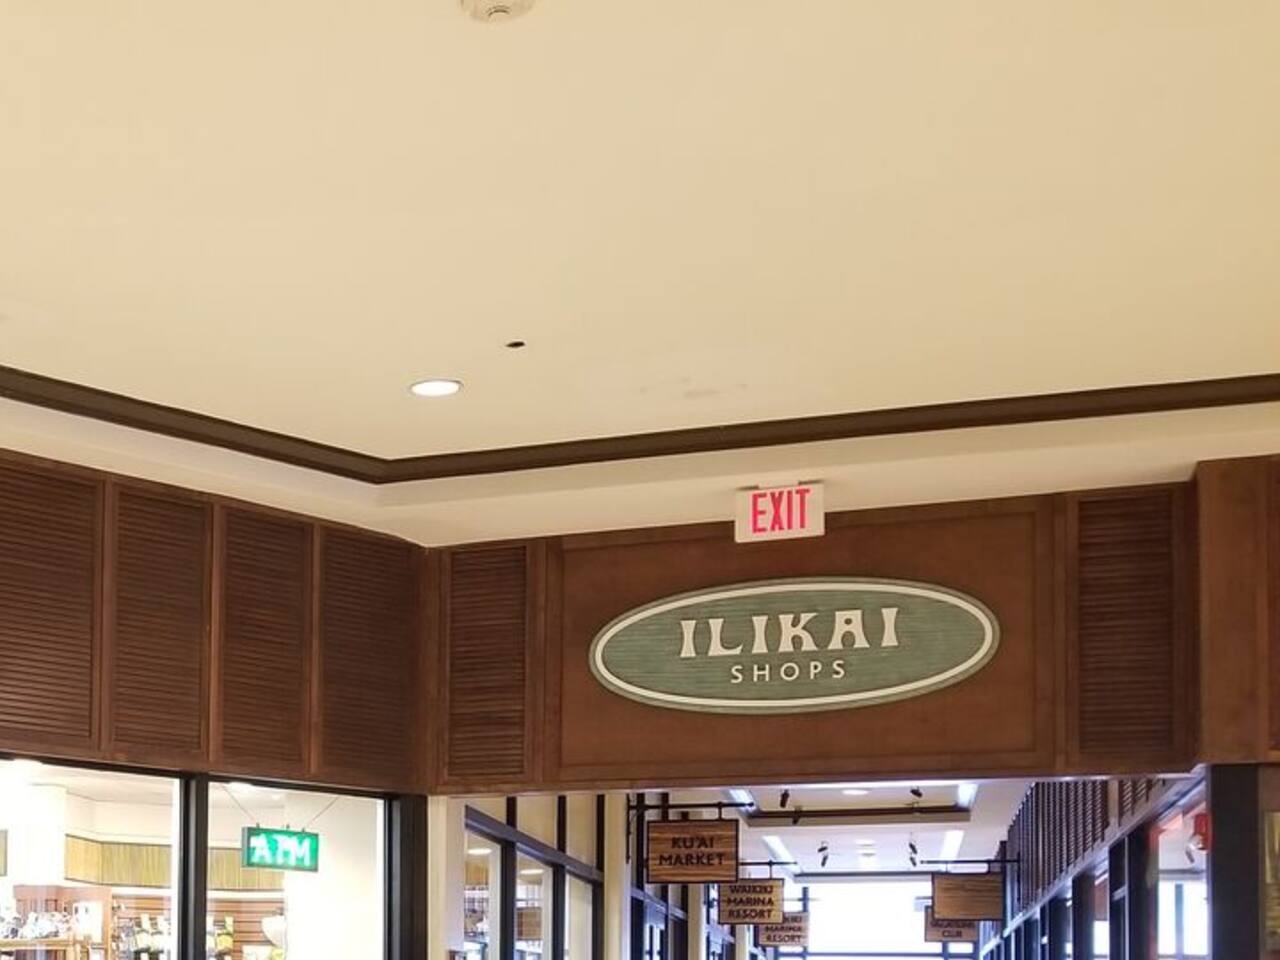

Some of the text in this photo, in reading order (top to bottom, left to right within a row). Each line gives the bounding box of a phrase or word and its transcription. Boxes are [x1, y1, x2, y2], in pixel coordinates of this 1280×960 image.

[751, 487, 811, 534] EXIT
[679, 607, 900, 659] ILIKAI
[730, 659, 846, 684] SHOPS
[250, 833, 311, 867] ATM
[658, 852, 725, 867] MARKET
[726, 897, 774, 907] MARINA
[727, 908, 773, 920] RESORT
[764, 925, 802, 933] MARINA
[765, 934, 802, 943] RESORT
